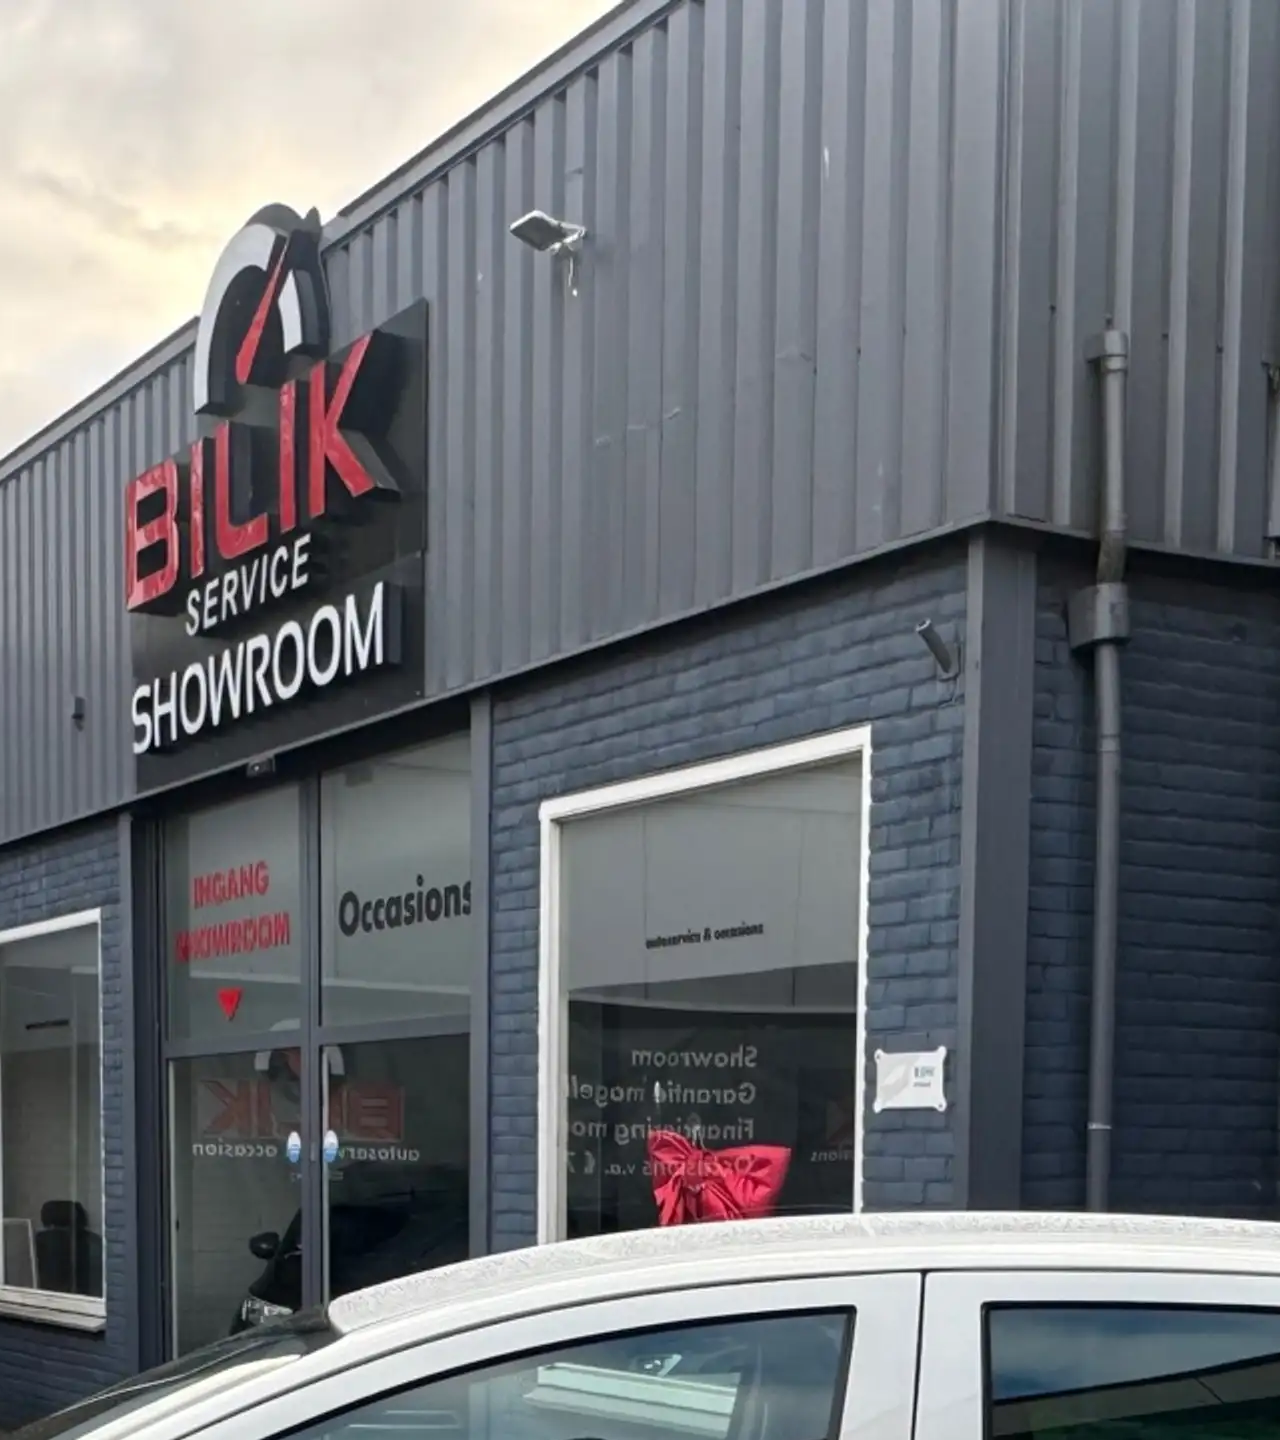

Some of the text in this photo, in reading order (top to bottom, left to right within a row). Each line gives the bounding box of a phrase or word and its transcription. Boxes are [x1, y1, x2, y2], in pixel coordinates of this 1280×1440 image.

[126, 333, 375, 610] BILIK
[185, 533, 311, 637] SERVICE
[132, 581, 384, 754] SHOWROOM
[193, 860, 269, 910] INGANG
[339, 874, 472, 937] Occasions
